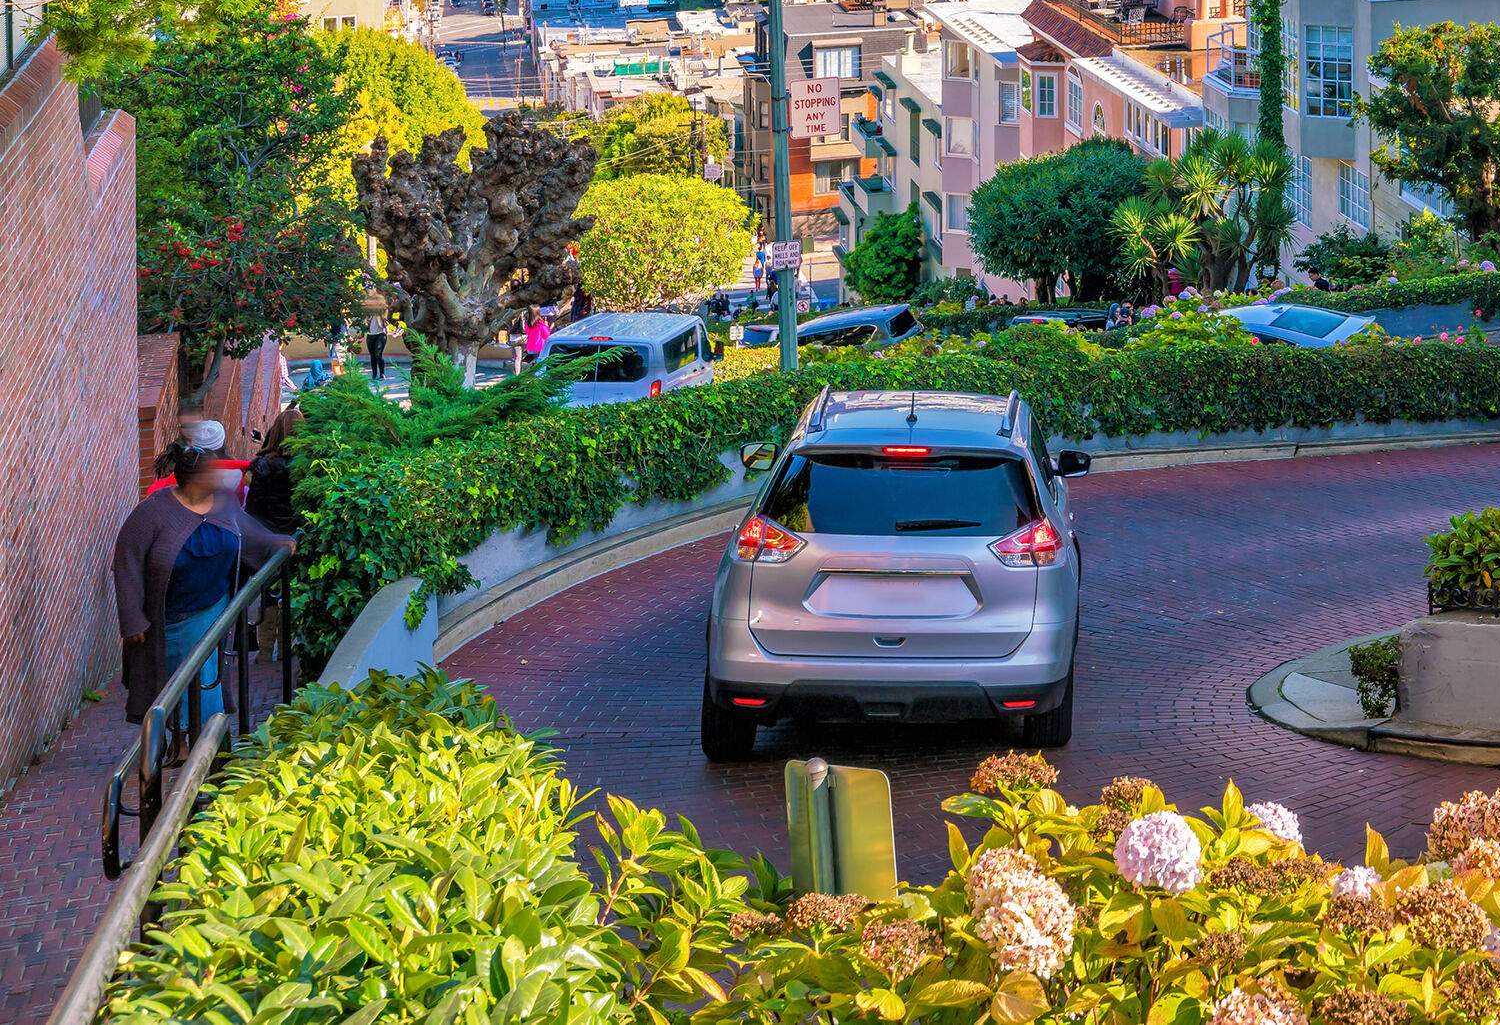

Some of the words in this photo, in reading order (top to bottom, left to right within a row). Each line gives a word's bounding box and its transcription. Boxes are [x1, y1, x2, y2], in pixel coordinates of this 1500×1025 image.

[807, 83, 822, 94] NO
[794, 96, 836, 110] STOPPING
[806, 112, 825, 121] ANY
[806, 124, 826, 133] TIME
